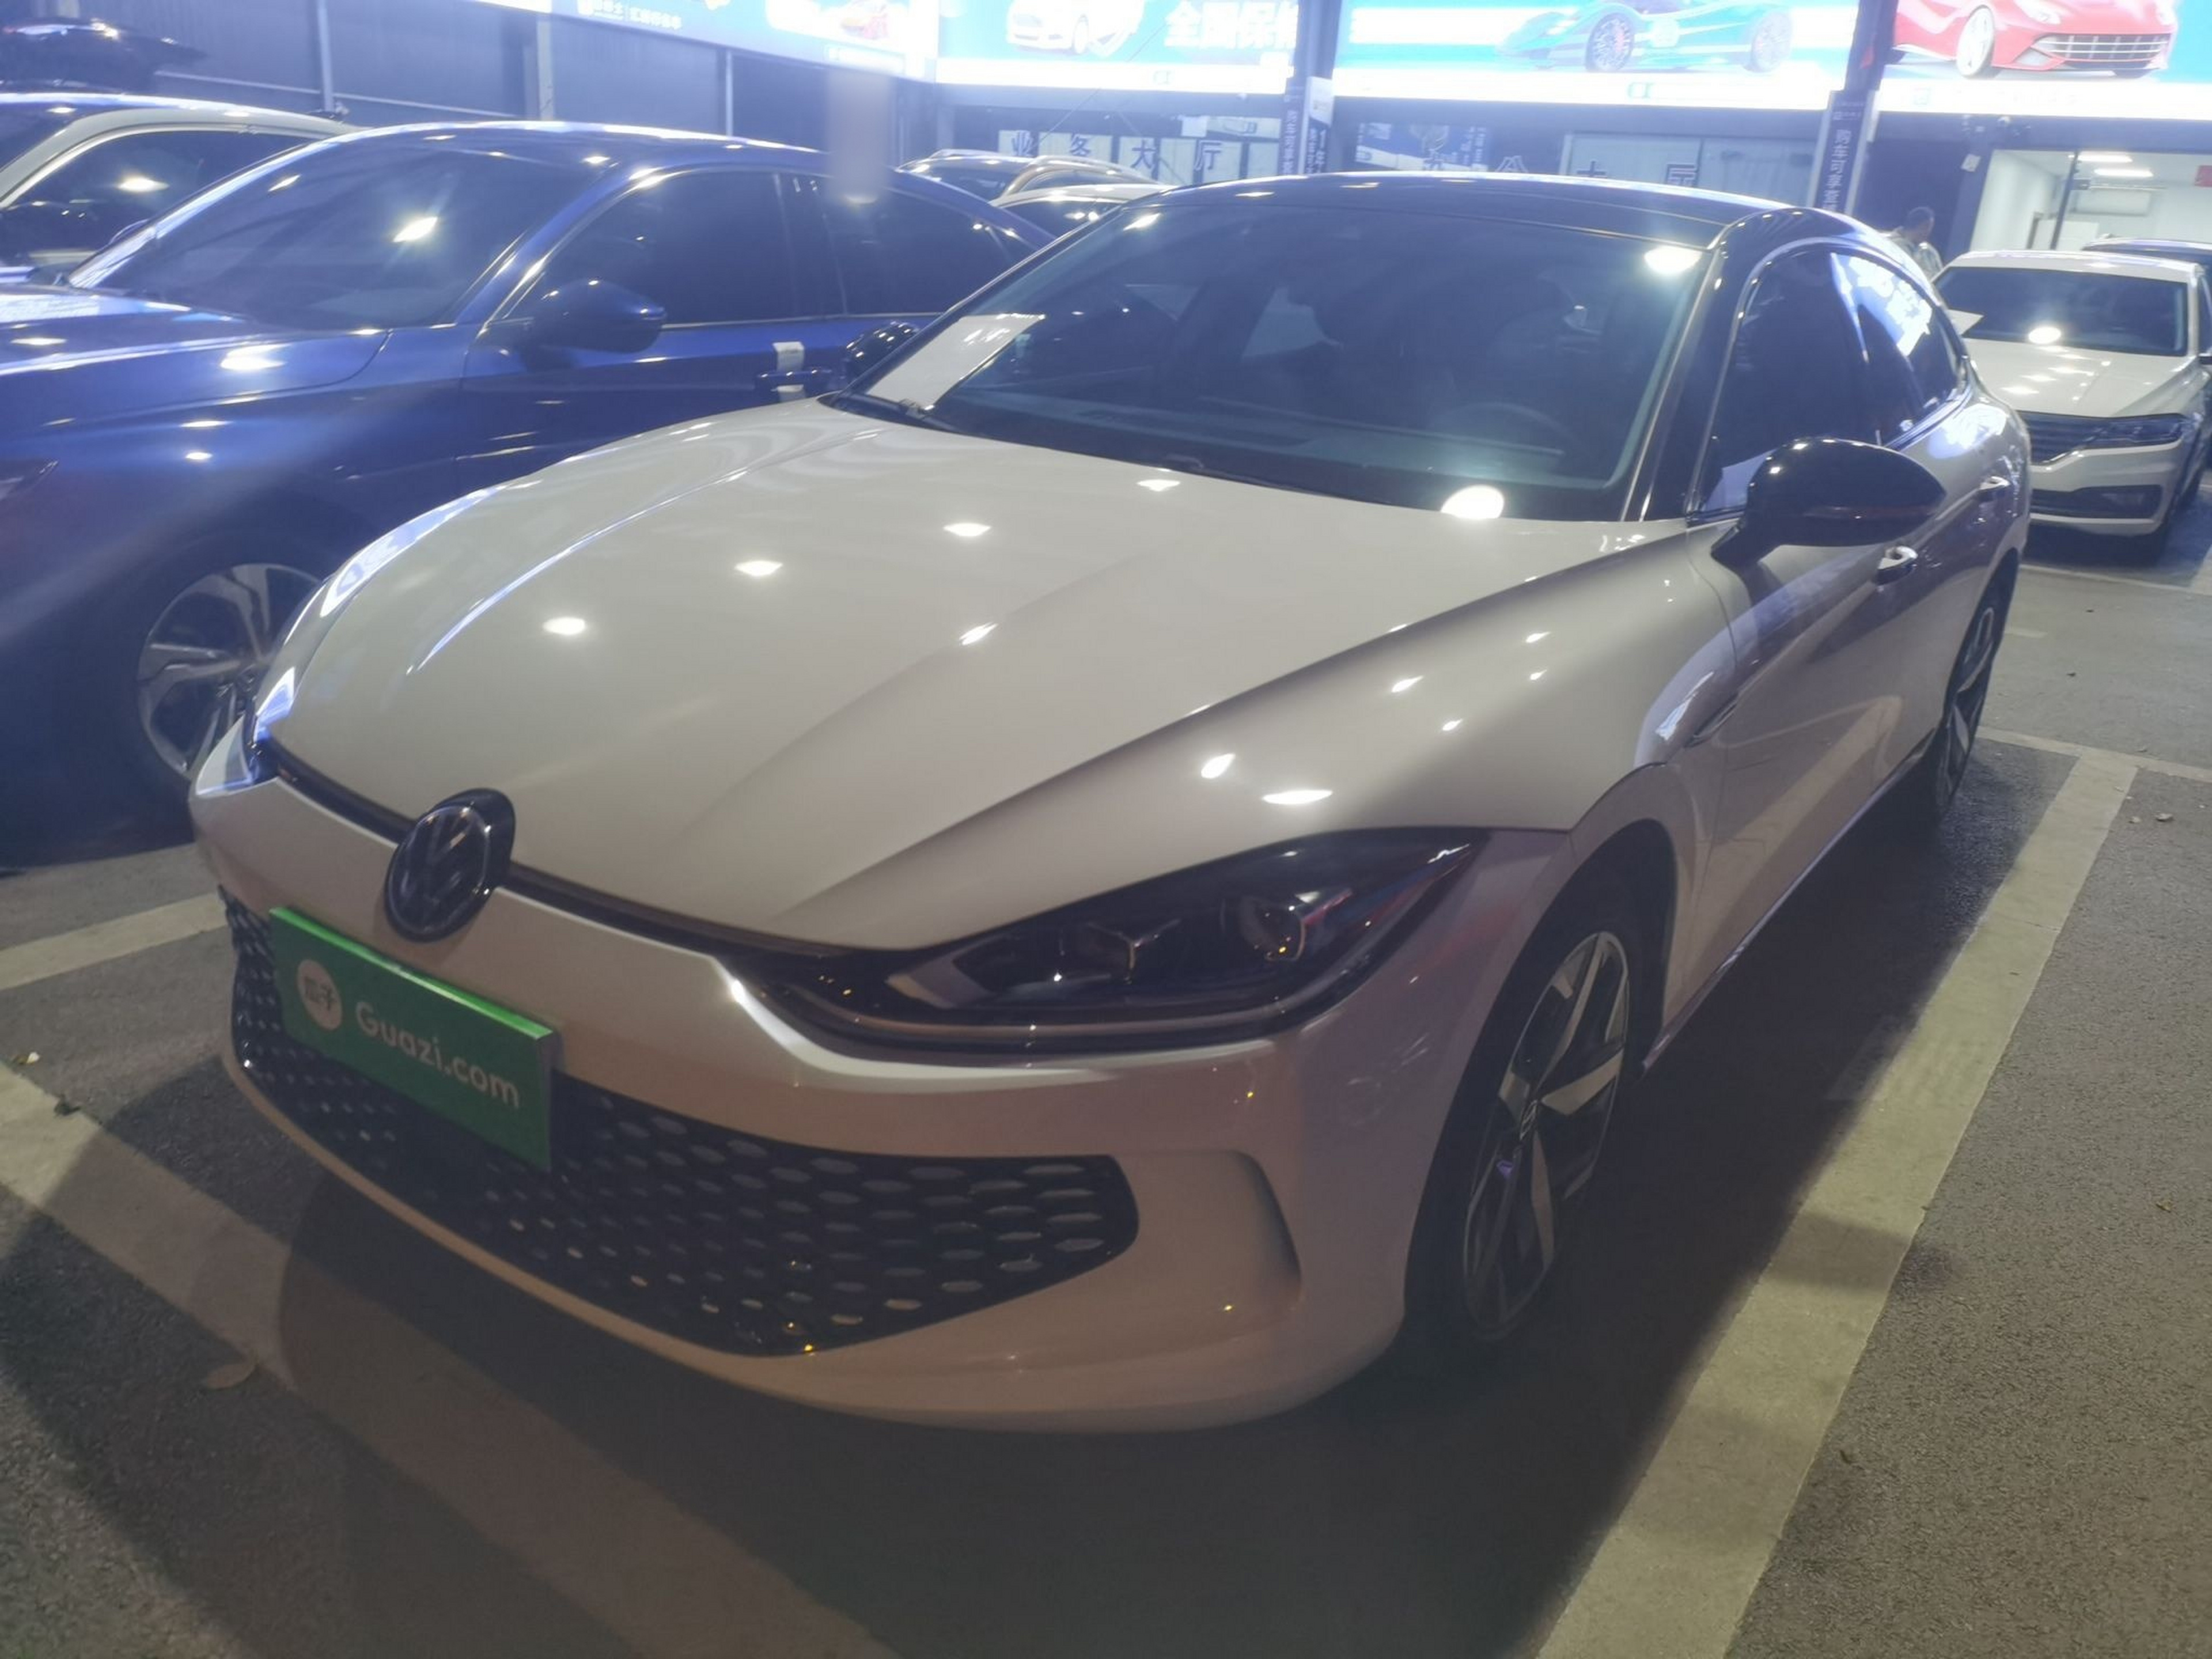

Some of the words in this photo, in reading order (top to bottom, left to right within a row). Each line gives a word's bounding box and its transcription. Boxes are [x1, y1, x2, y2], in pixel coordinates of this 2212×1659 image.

[1012, 130, 1222, 171] 业务大厅
[355, 1001, 521, 1109] Guazi.com
